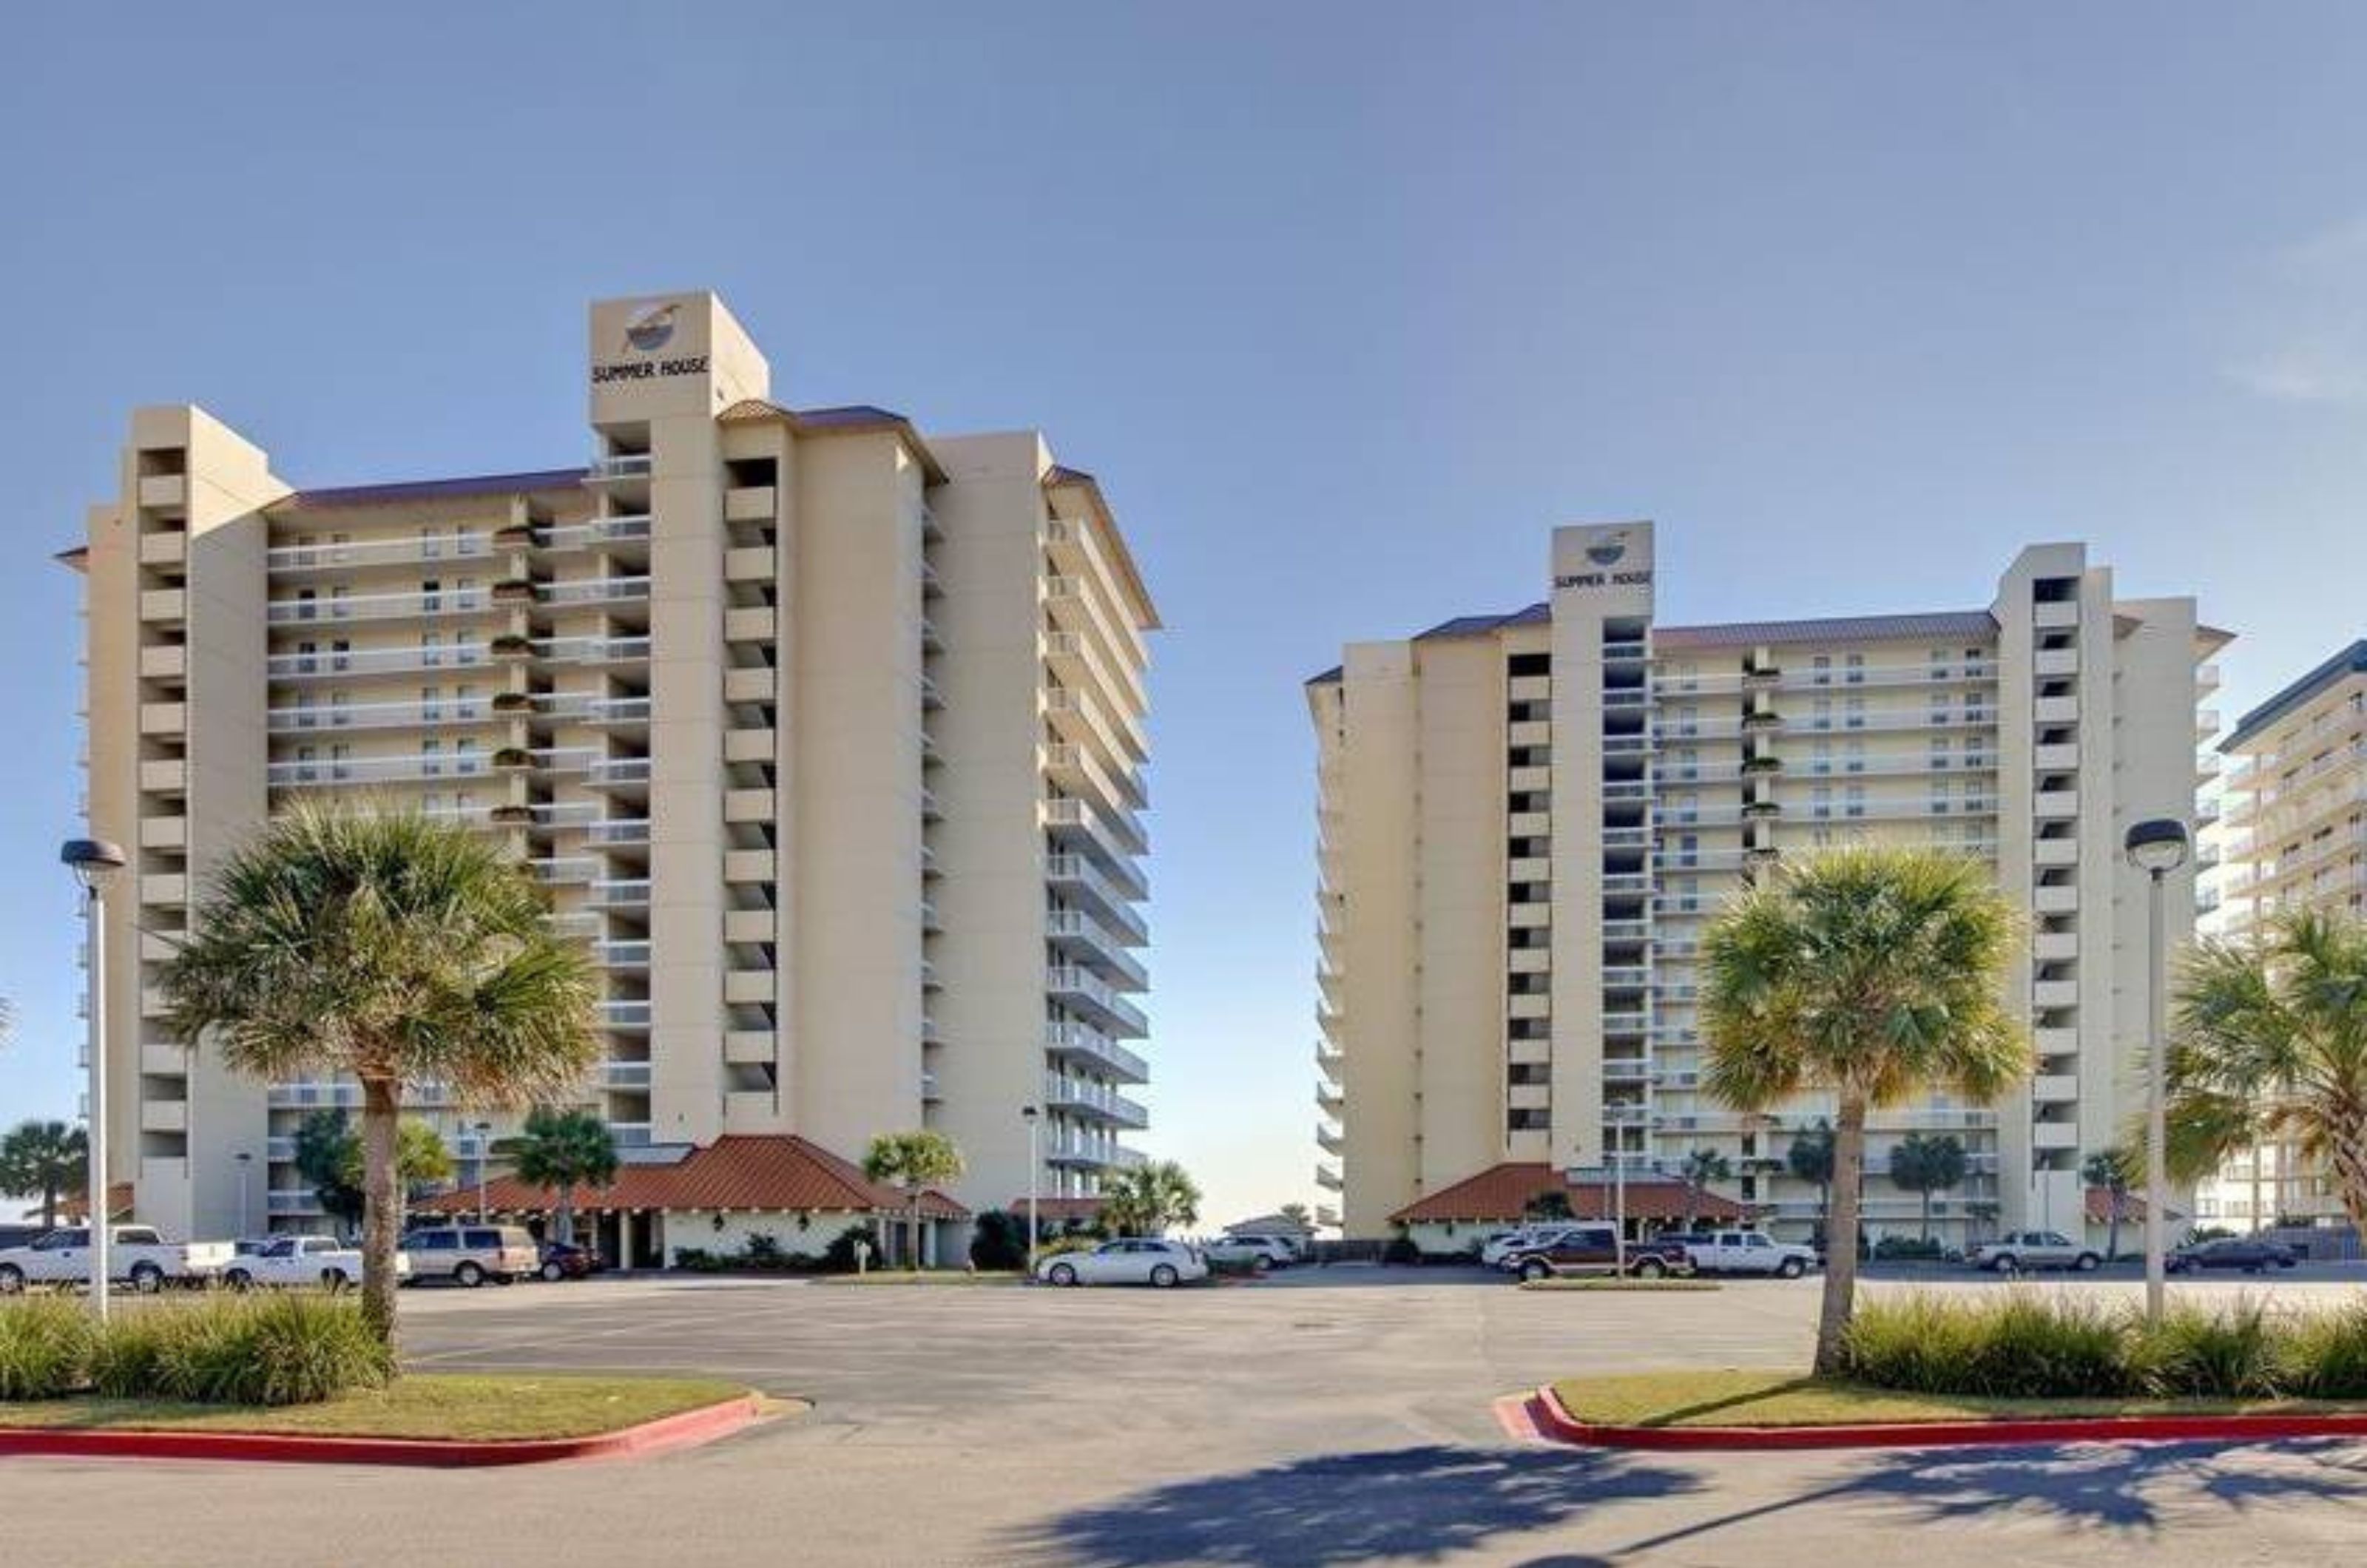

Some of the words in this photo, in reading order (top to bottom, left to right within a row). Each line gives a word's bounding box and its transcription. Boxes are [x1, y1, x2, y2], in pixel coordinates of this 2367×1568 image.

[592, 361, 654, 383] SUMMER
[661, 356, 709, 376] HOUSE
[1555, 573, 1606, 589] SUMMER
[1613, 570, 1653, 585] HOUSE
